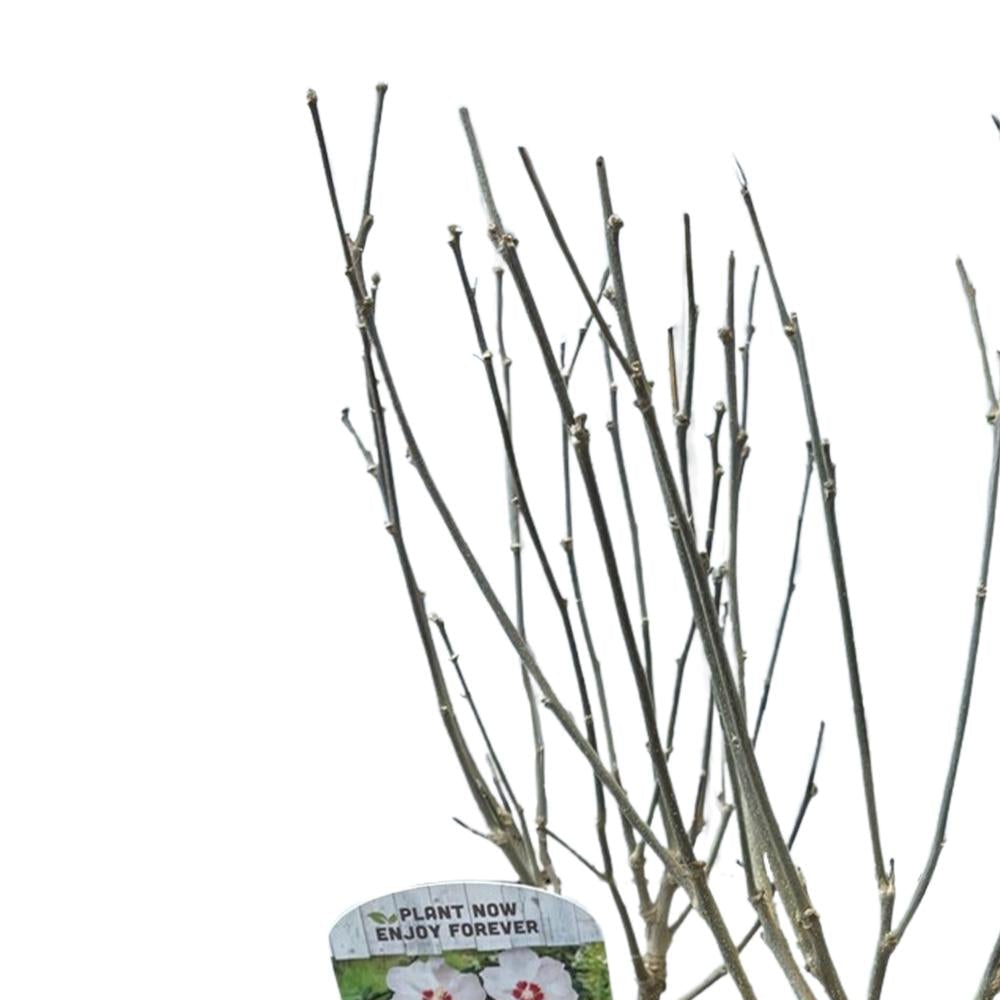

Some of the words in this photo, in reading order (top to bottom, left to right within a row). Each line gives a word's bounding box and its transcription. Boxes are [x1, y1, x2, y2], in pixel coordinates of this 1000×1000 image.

[400, 904, 465, 922] PLANT
[473, 902, 517, 918] NOW
[376, 924, 441, 942] ENJOY
[449, 920, 540, 938] FOREVER
